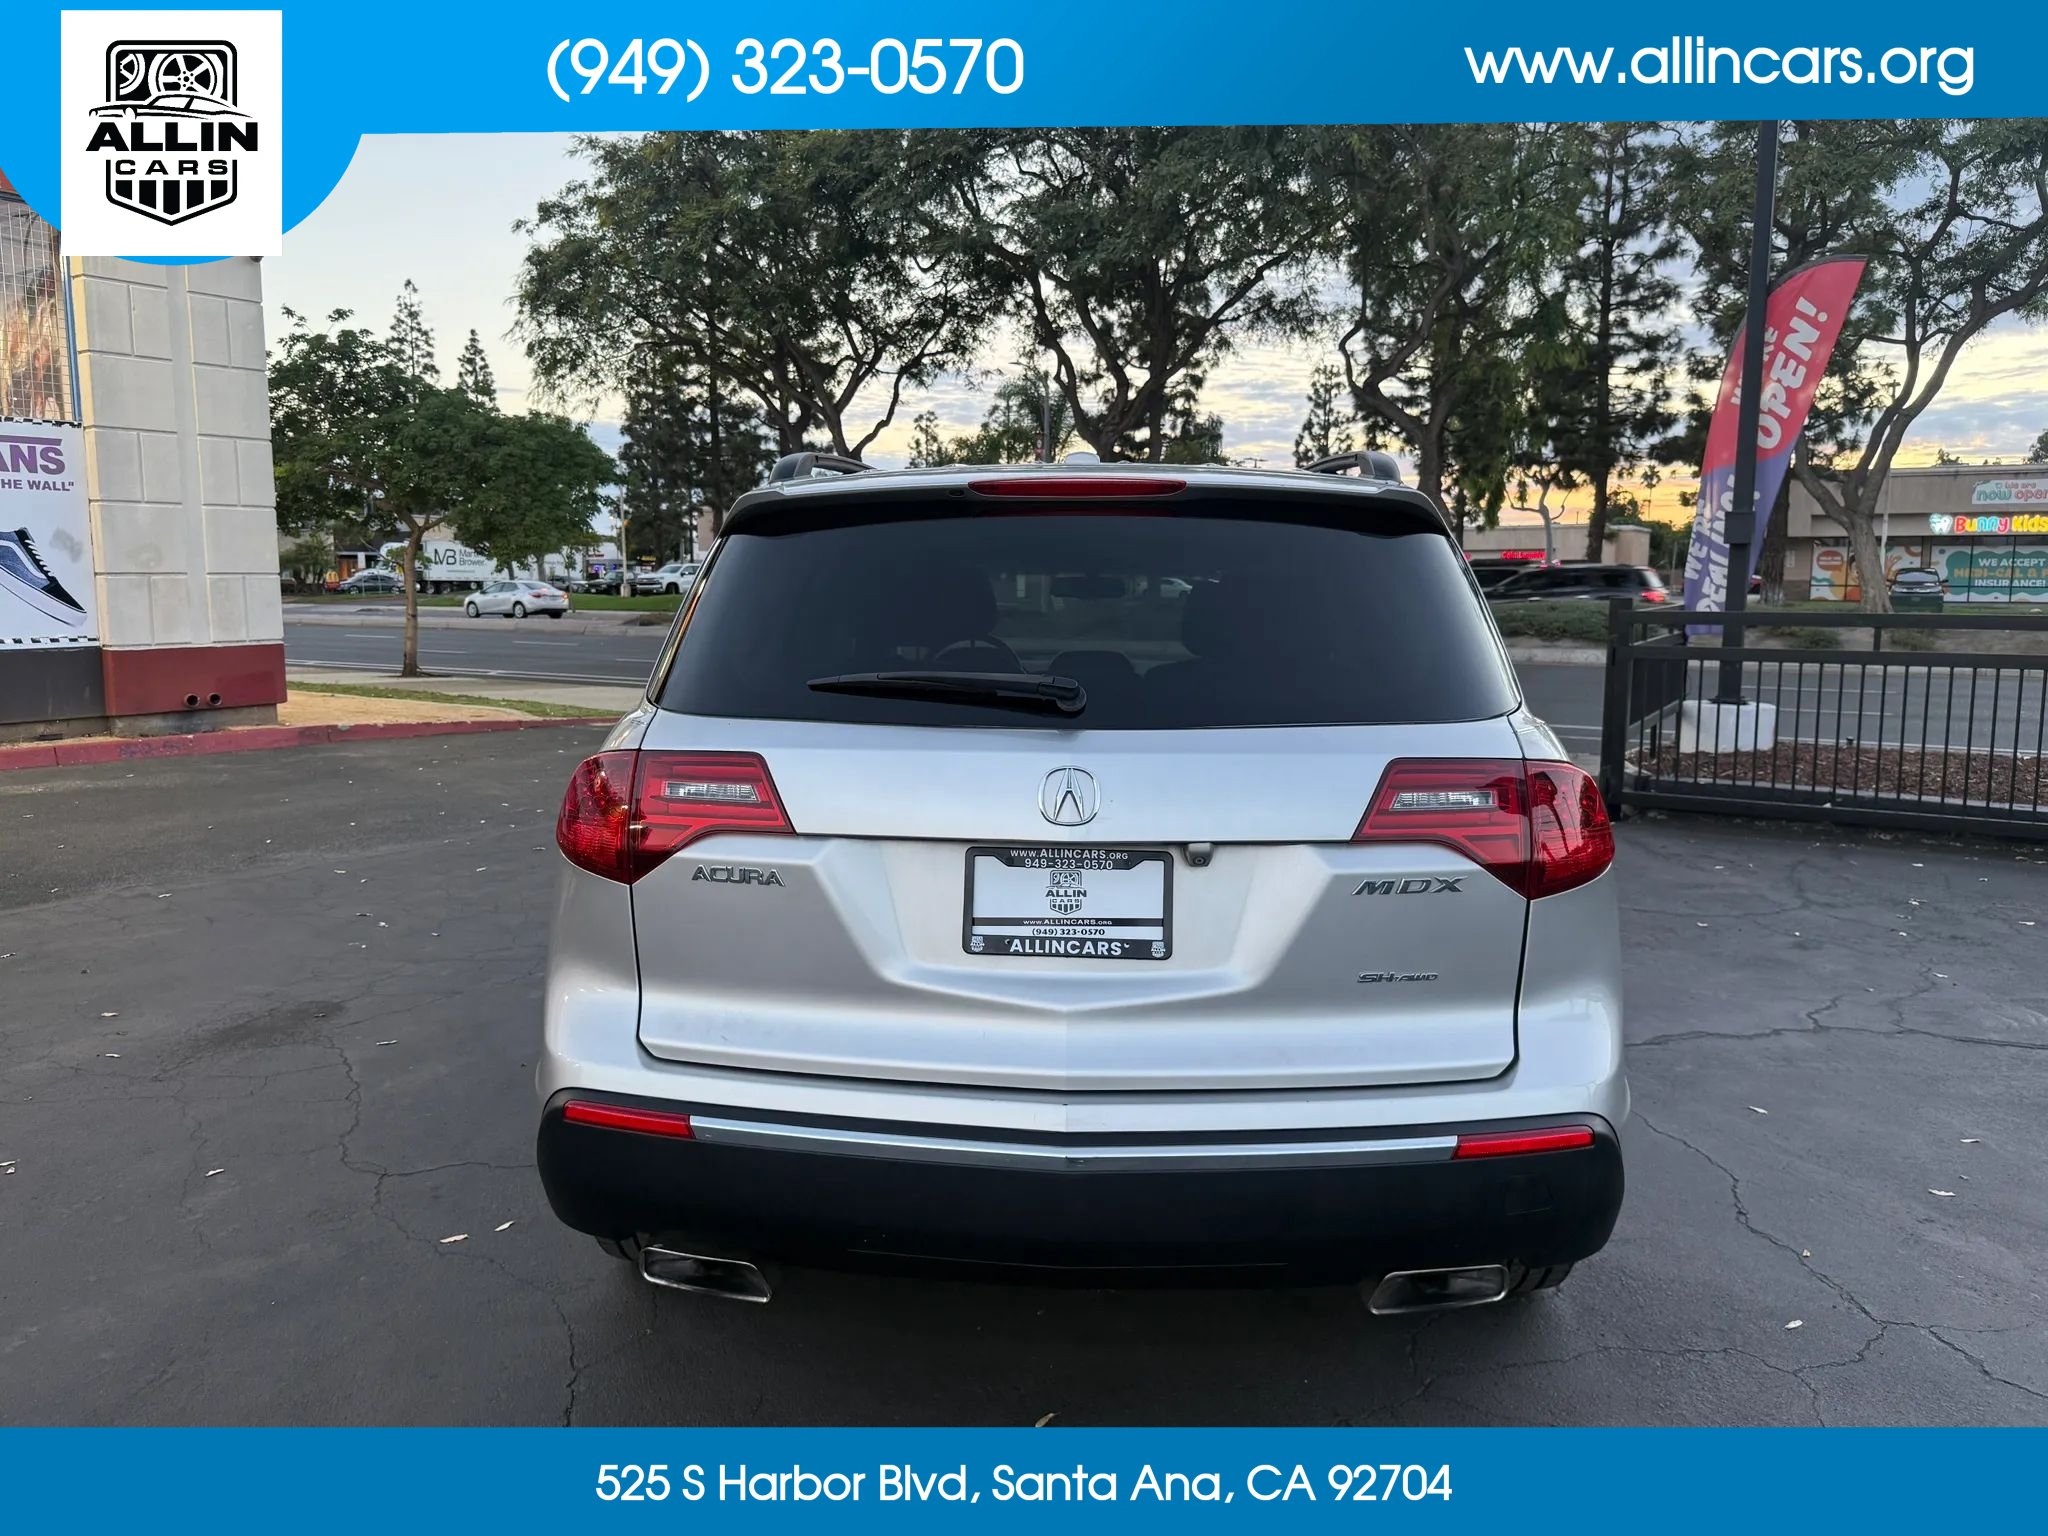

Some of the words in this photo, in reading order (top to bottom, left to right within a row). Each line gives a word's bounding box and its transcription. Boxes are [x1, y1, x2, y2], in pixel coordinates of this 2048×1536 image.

[1755, 296, 1829, 449] OPEN!
[27, 480, 74, 492] WALL"
[1976, 489, 2012, 501] now
[1954, 515, 2010, 534] Bunny
[1978, 558, 1997, 567] WE
[1999, 558, 2046, 567] ACCEPT
[1024, 858, 1113, 870] 949-323-0570
[691, 864, 785, 887] ACURA
[1351, 876, 1468, 896] MDX
[1045, 889, 1087, 898] ALLIN
[1032, 928, 1058, 936] (949)
[1010, 938, 1122, 956] ALLINCARS
